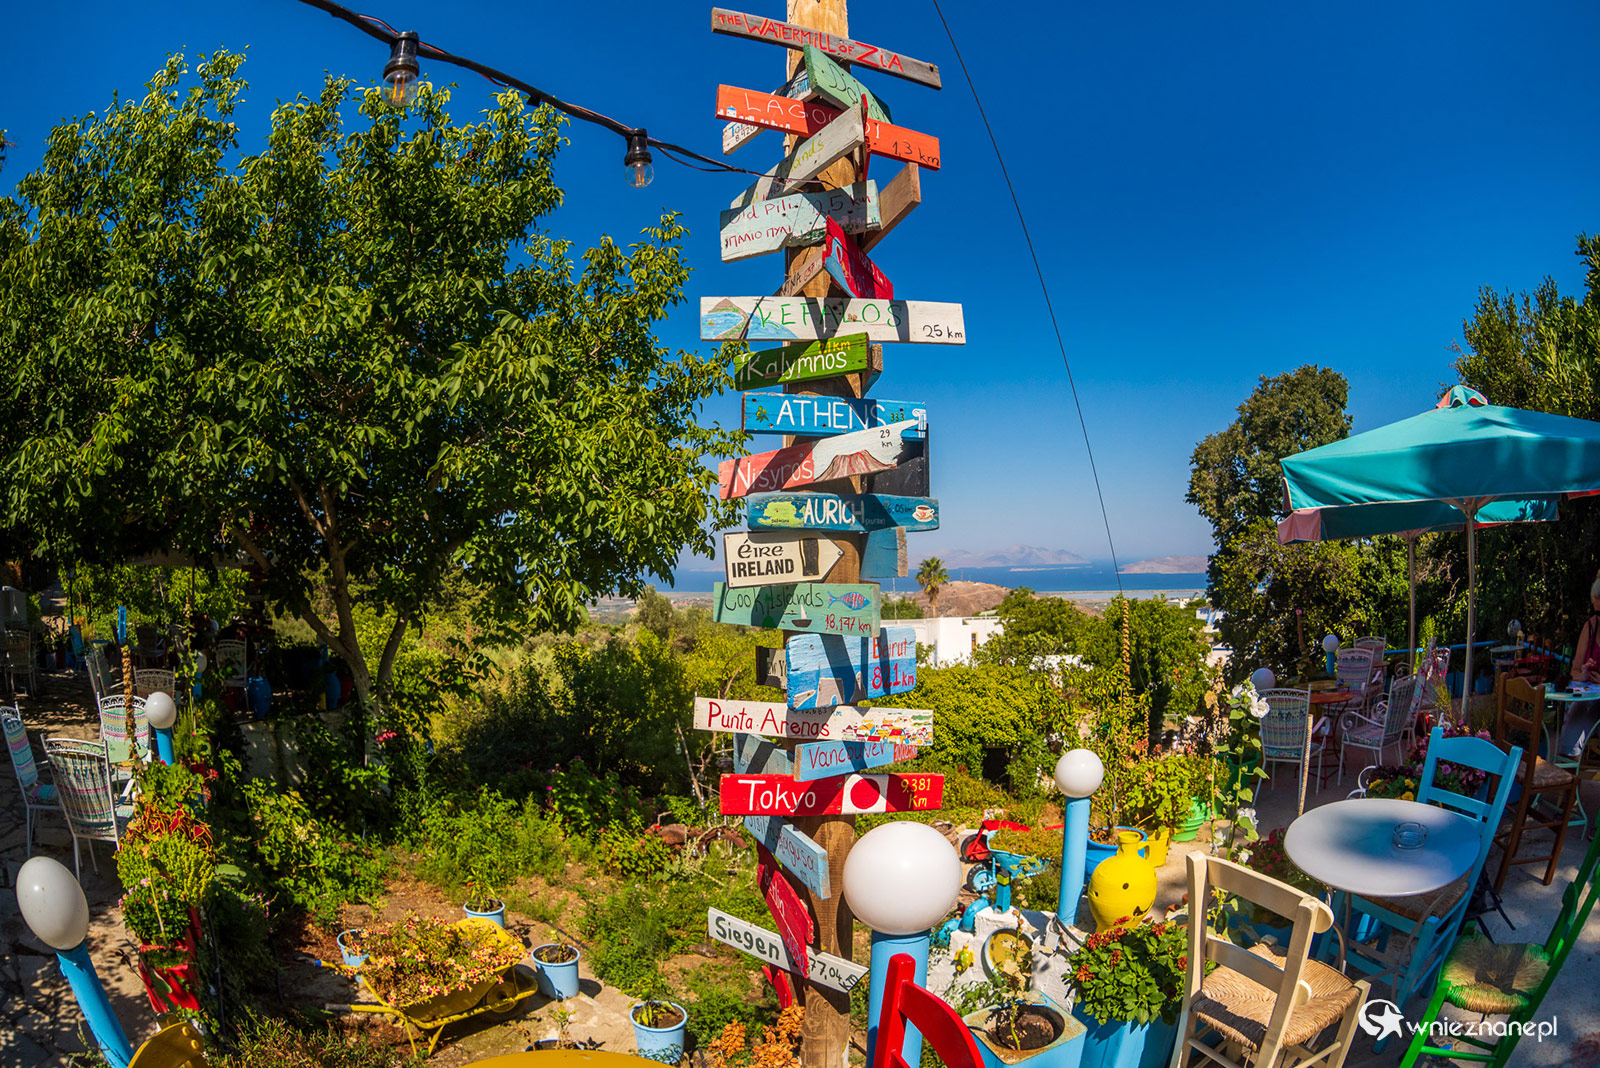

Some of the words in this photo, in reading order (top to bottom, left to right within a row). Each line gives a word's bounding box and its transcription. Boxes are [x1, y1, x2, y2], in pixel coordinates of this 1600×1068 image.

[715, 14, 743, 26] THE
[918, 147, 940, 166] km
[755, 301, 903, 329] KEFALOS
[923, 325, 943, 339] 25
[946, 326, 963, 339] km
[776, 400, 887, 430] ATHENS
[890, 412, 905, 423] 333
[879, 429, 891, 439] 29
[881, 439, 893, 449] km
[734, 460, 813, 493] Nisyros
[803, 498, 865, 525] AURICH
[731, 558, 795, 579] IRELAND
[724, 587, 764, 616] Cook
[769, 584, 824, 609] Islands
[858, 616, 872, 632] km
[872, 637, 909, 659] Beirut
[872, 662, 900, 690] 821
[901, 671, 915, 687] km
[708, 701, 753, 731] Punta
[760, 708, 831, 737] Arenas
[808, 743, 885, 770] Vancouver
[738, 779, 816, 813] Tokyo
[714, 916, 780, 962] Siegen
